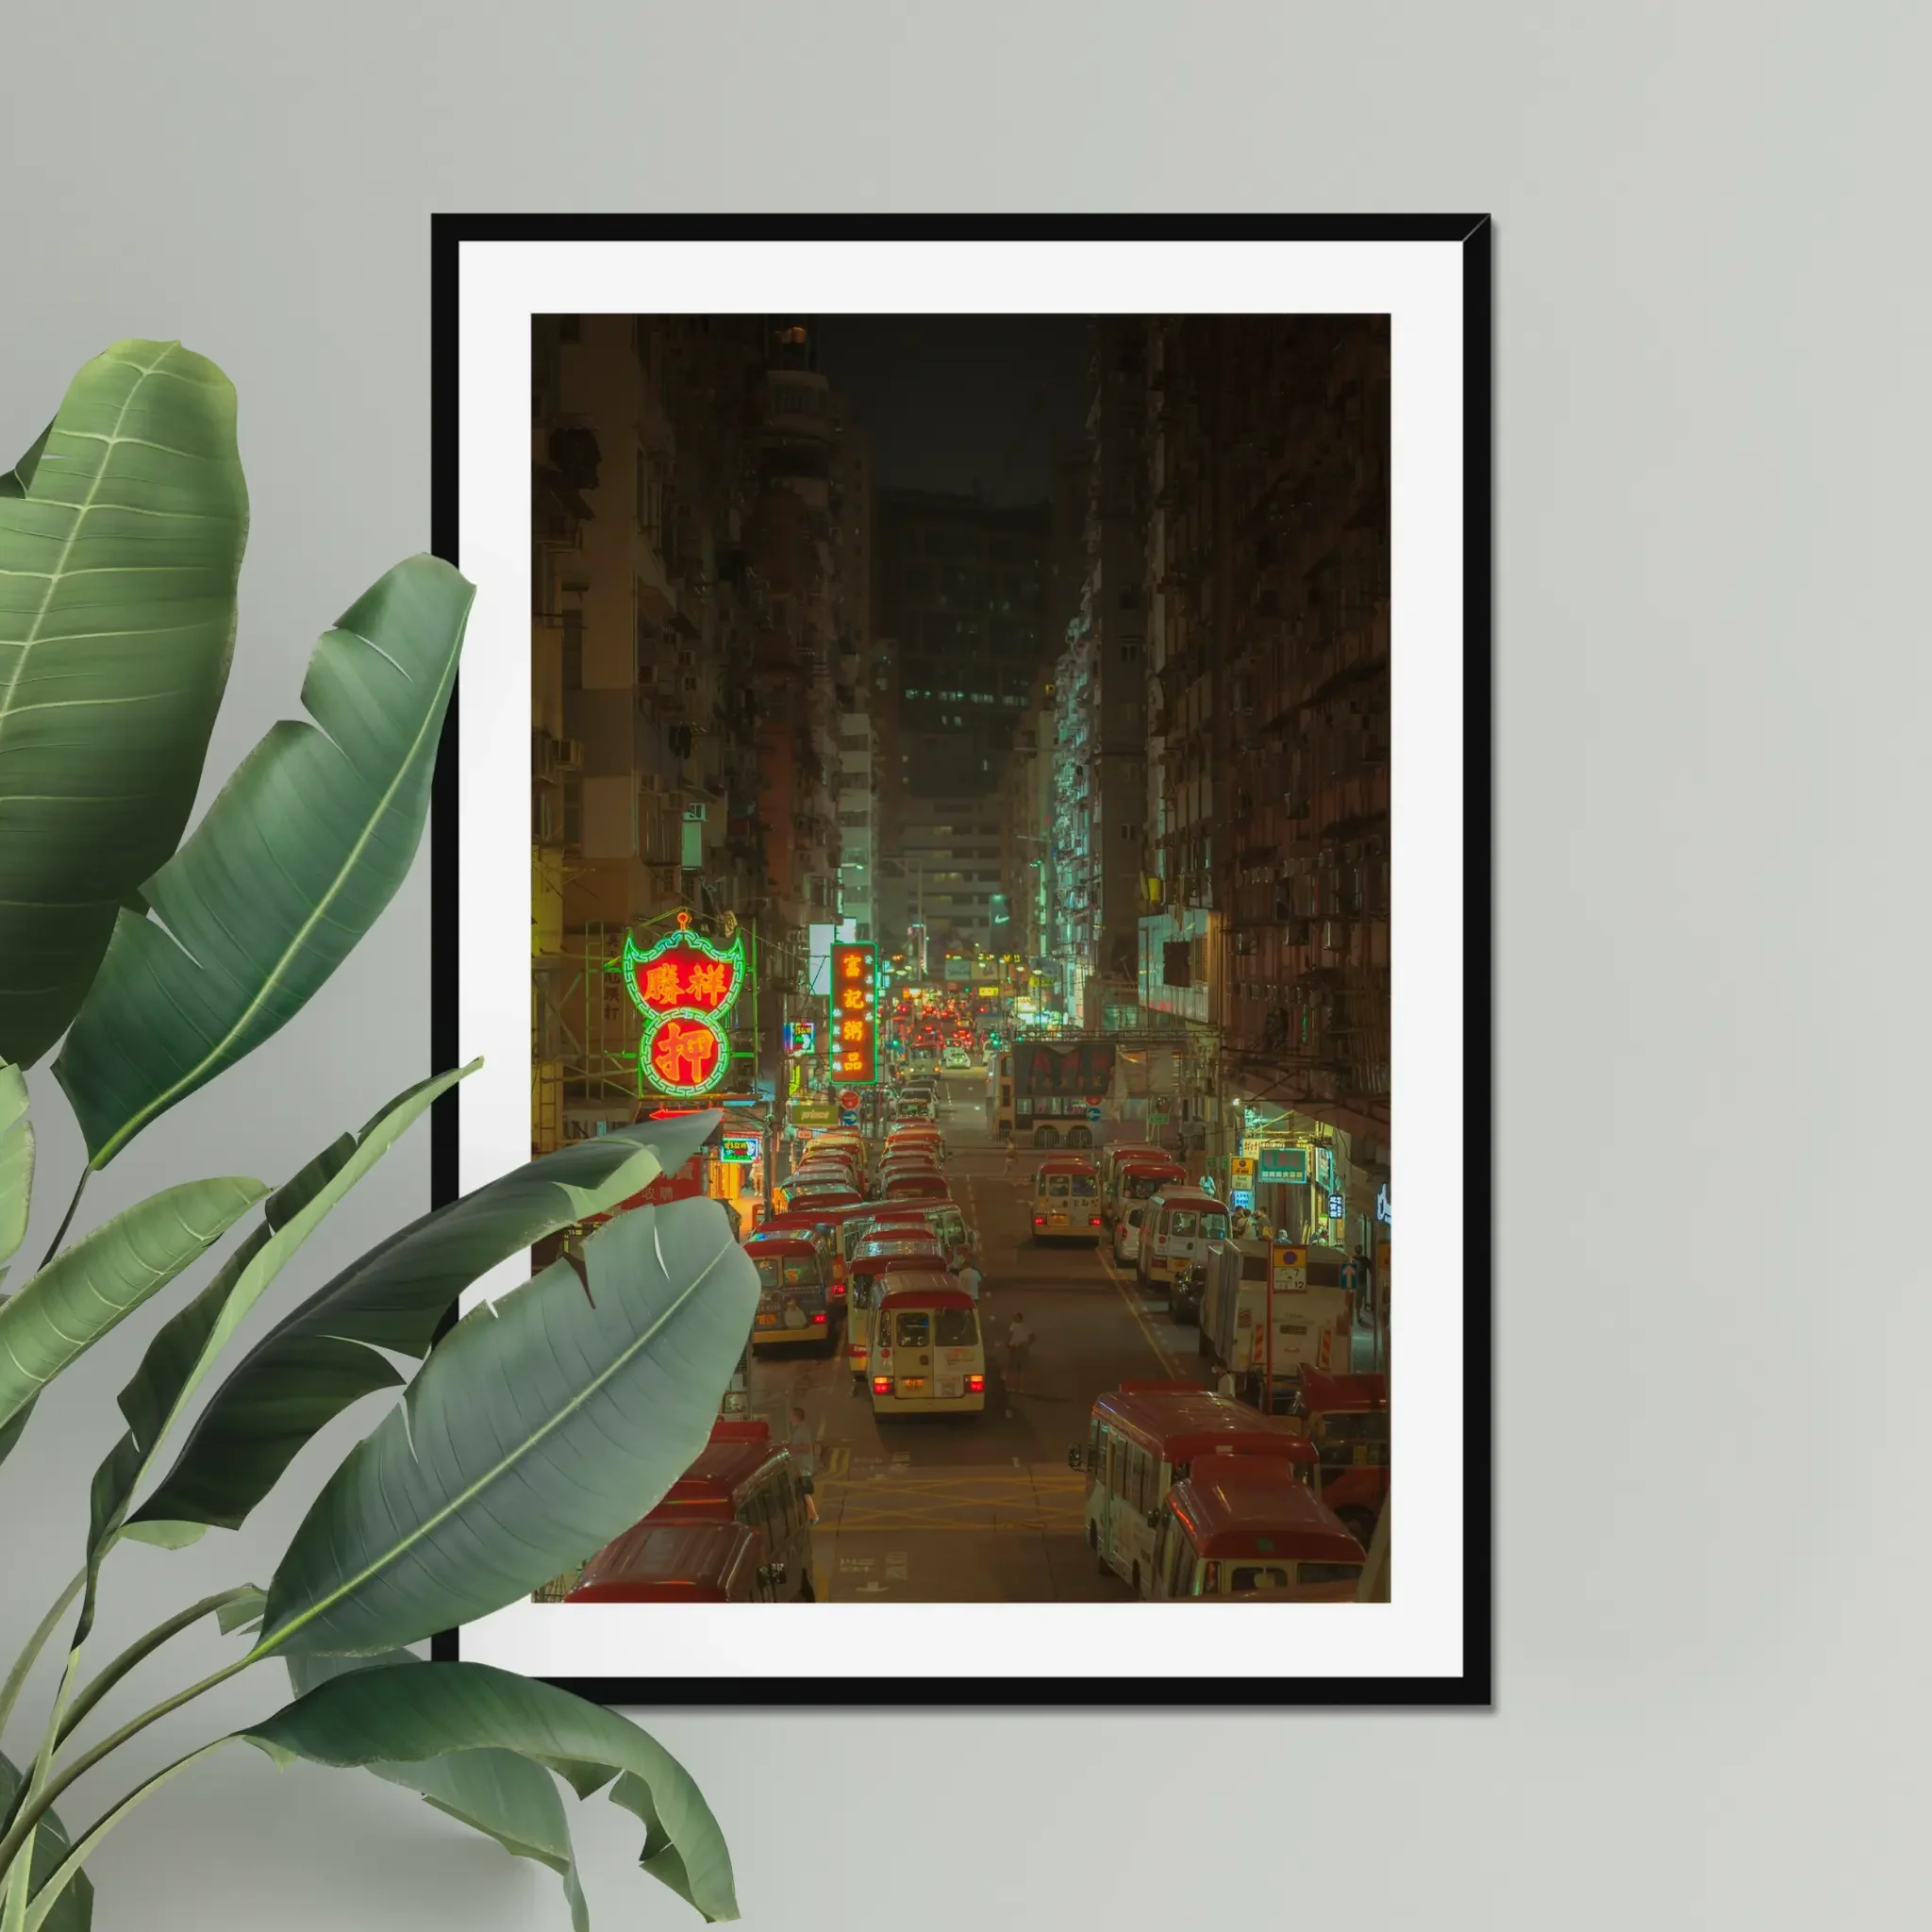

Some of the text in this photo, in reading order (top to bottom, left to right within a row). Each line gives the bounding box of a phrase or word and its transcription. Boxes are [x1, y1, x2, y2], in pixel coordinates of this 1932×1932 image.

[656, 1022, 715, 1084] 押
[843, 955, 864, 1071] 富記粥品
